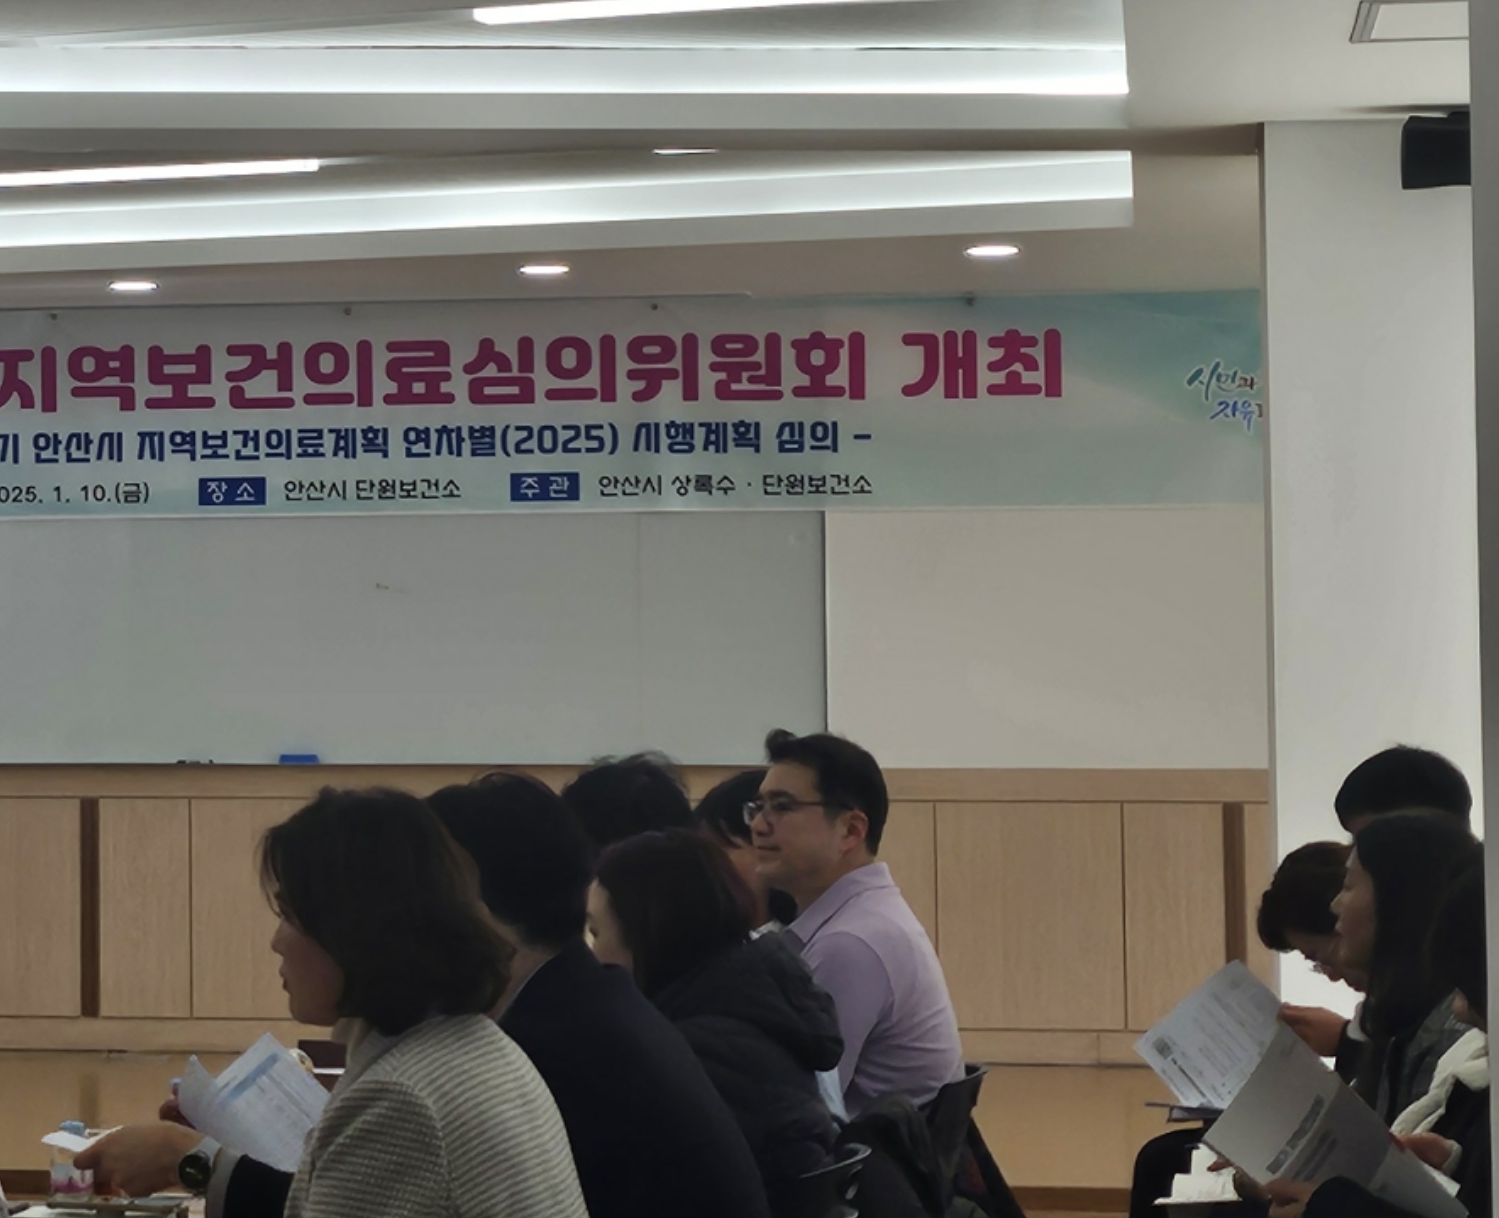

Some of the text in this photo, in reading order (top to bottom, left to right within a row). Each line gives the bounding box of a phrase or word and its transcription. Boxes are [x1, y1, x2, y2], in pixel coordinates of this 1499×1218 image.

[901, 328, 1063, 399] 개최
[33, 431, 124, 464] 안산시
[137, 426, 390, 462] 지역보건의료계획
[402, 423, 620, 459] 연차별(2025)
[632, 420, 761, 454] 시행계획
[775, 419, 840, 454] 심의
[81, 481, 150, 505] 10.(금)
[284, 479, 347, 502] 안산시
[356, 477, 462, 502] 단원보건소
[599, 474, 662, 497] 안산시
[671, 474, 736, 496] 상록수
[762, 474, 873, 496] 단원보건소
